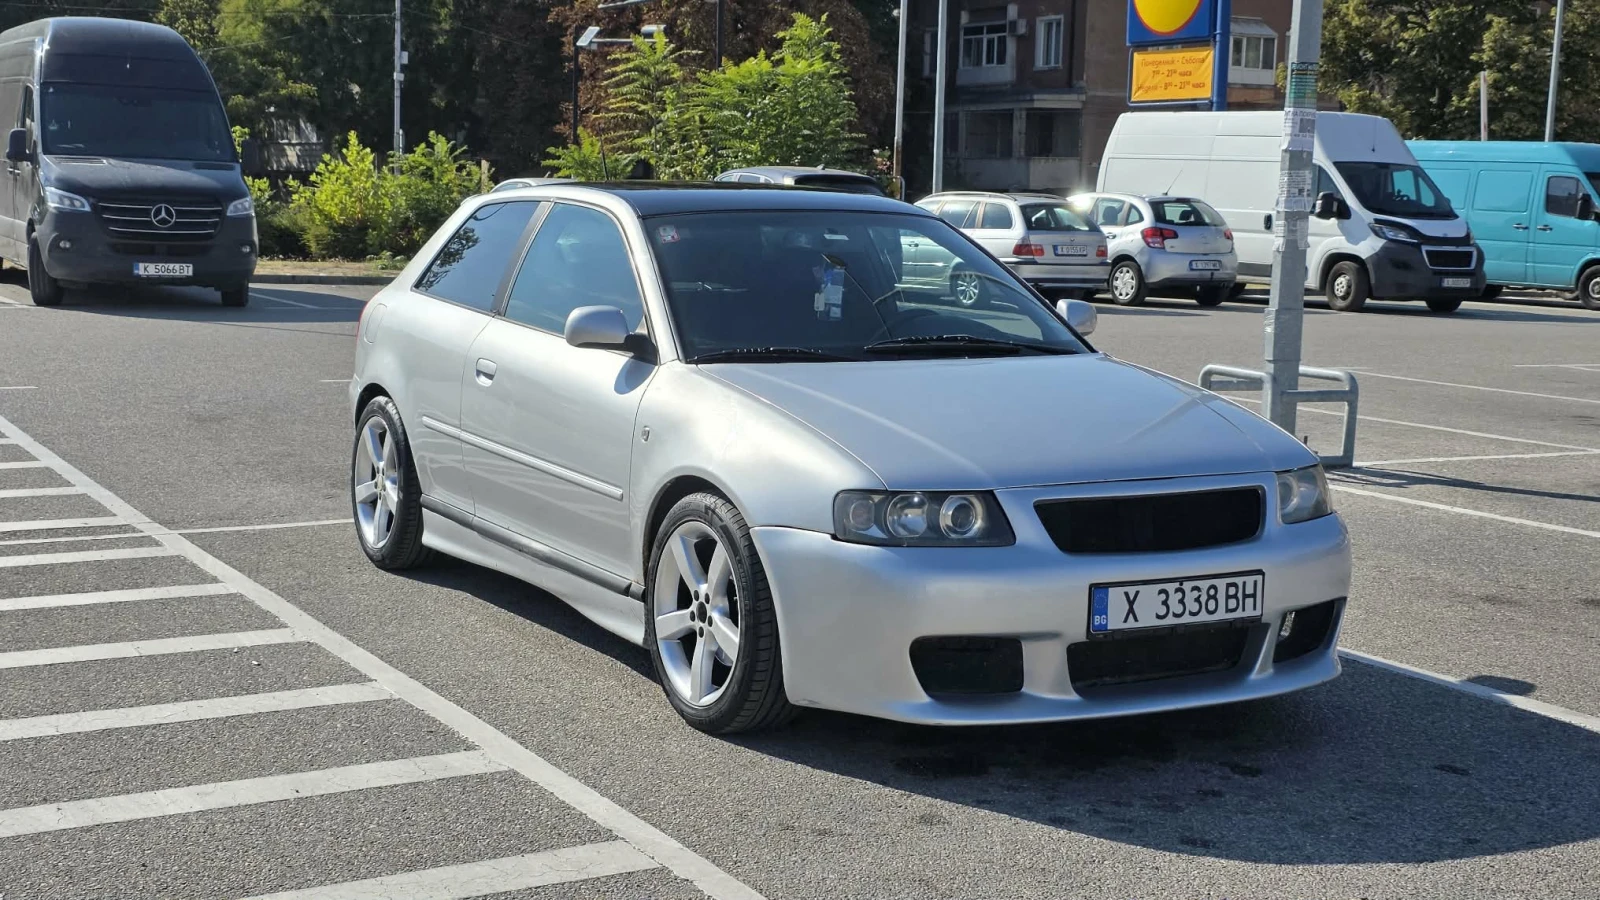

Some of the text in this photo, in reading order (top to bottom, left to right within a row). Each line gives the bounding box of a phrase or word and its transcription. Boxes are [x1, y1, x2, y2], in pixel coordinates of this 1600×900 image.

[1141, 58, 1175, 69] Понеделник
[1181, 56, 1206, 65] Събота
[144, 264, 150, 274] K
[1123, 590, 1140, 624] X
[1094, 615, 1107, 625] BG
